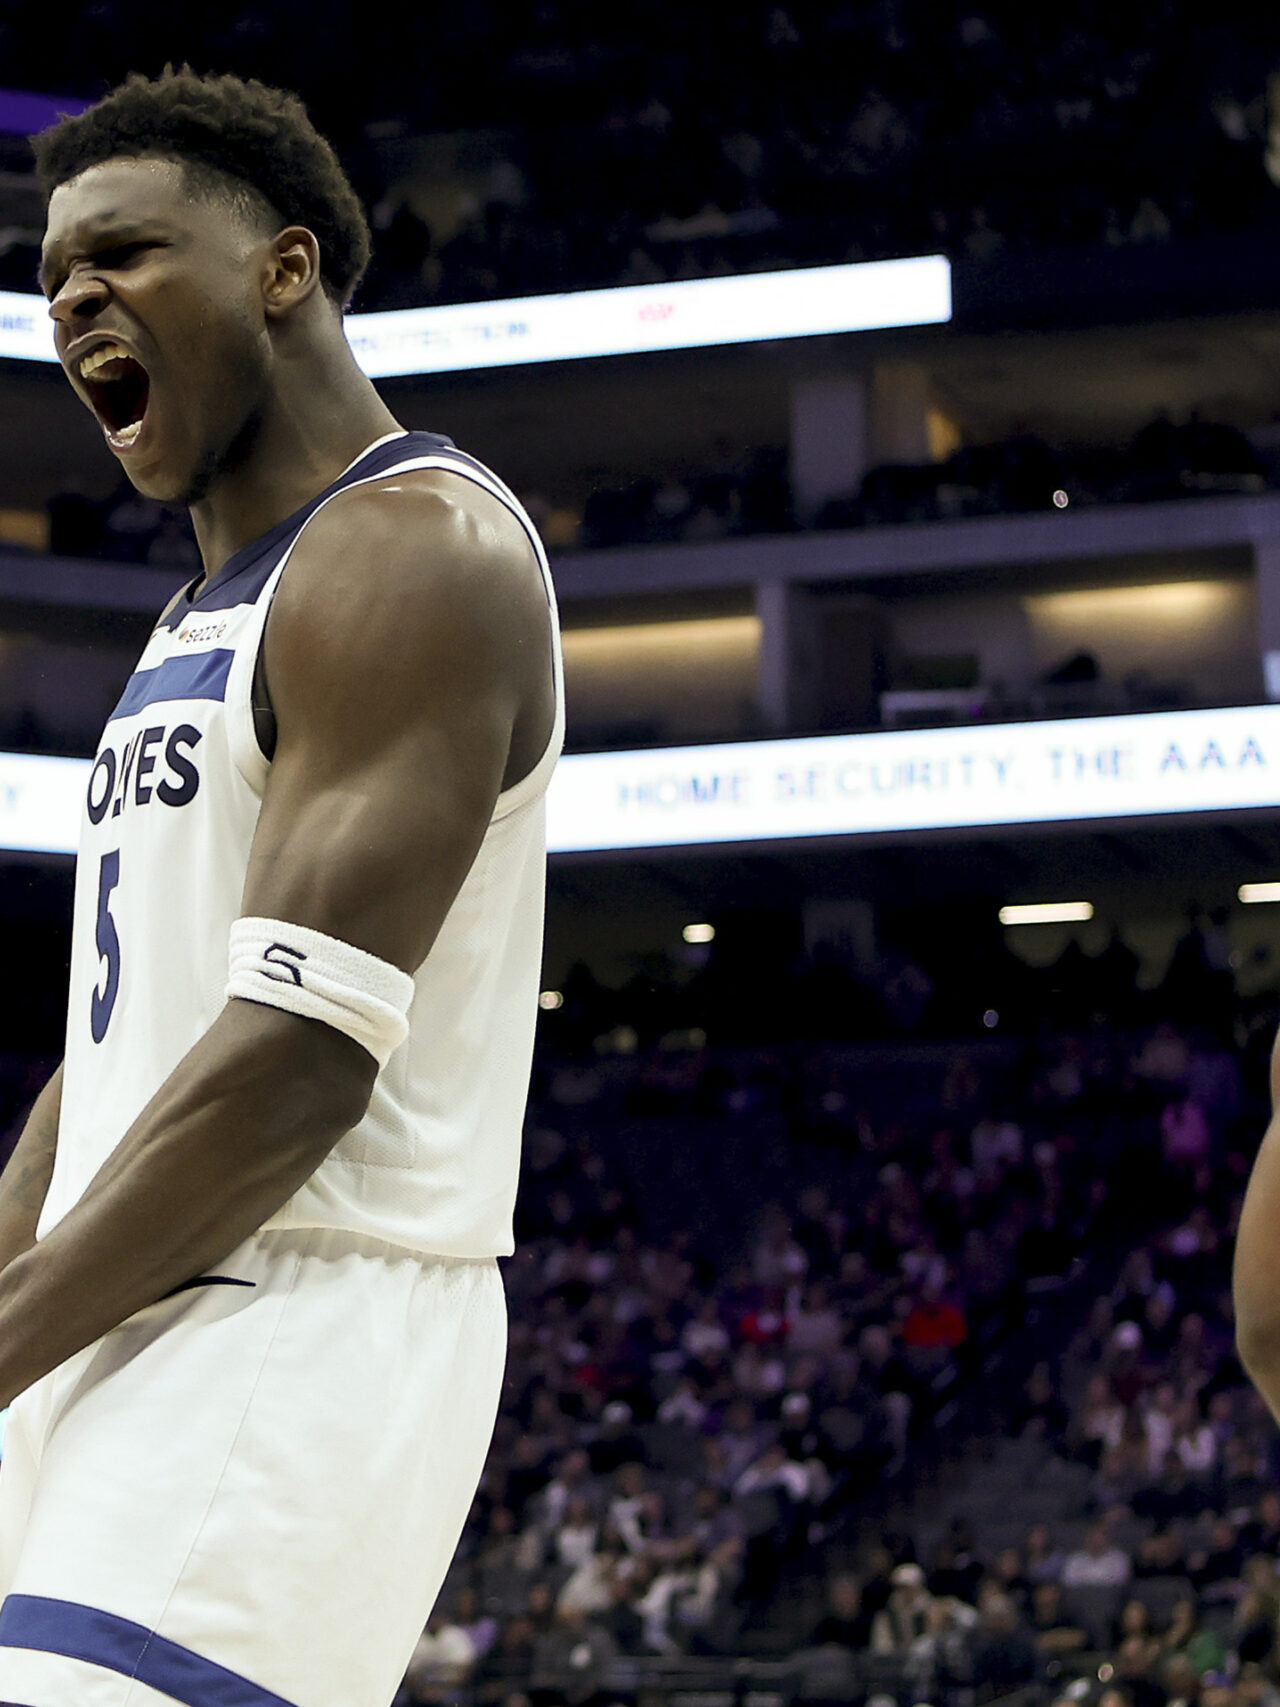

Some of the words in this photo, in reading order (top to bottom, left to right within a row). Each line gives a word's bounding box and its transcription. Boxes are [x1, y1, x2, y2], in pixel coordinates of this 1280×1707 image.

[616, 766, 753, 815] HOME
[1046, 740, 1138, 784] THE
[1158, 733, 1270, 778] AAA
[90, 847, 121, 1045] 5
